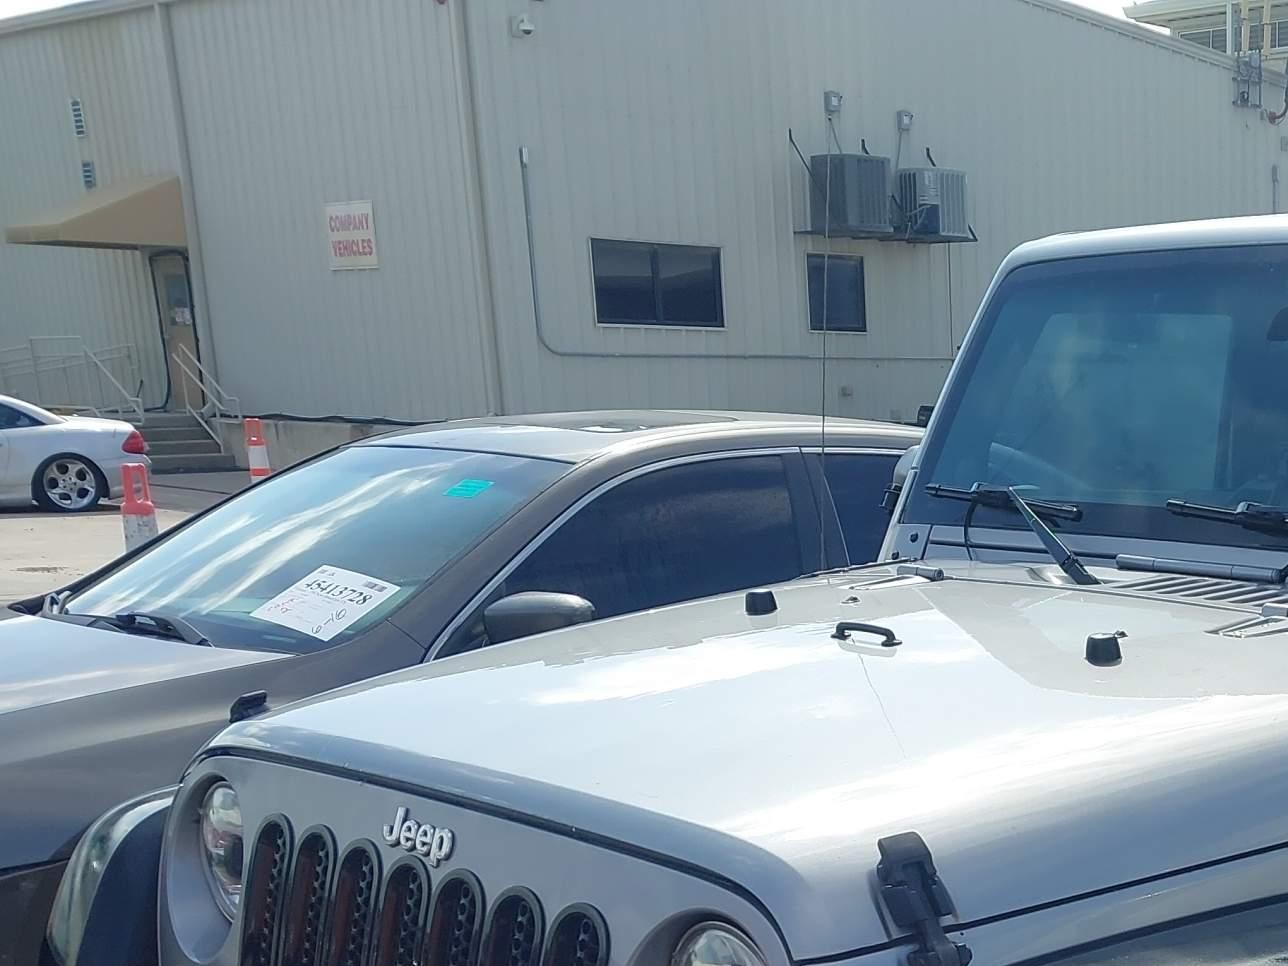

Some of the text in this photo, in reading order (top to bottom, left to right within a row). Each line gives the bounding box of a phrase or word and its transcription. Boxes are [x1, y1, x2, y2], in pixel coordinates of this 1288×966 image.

[328, 212, 369, 232] COMPANY
[332, 238, 373, 257] VEHICLES
[383, 806, 455, 868] Jeep
